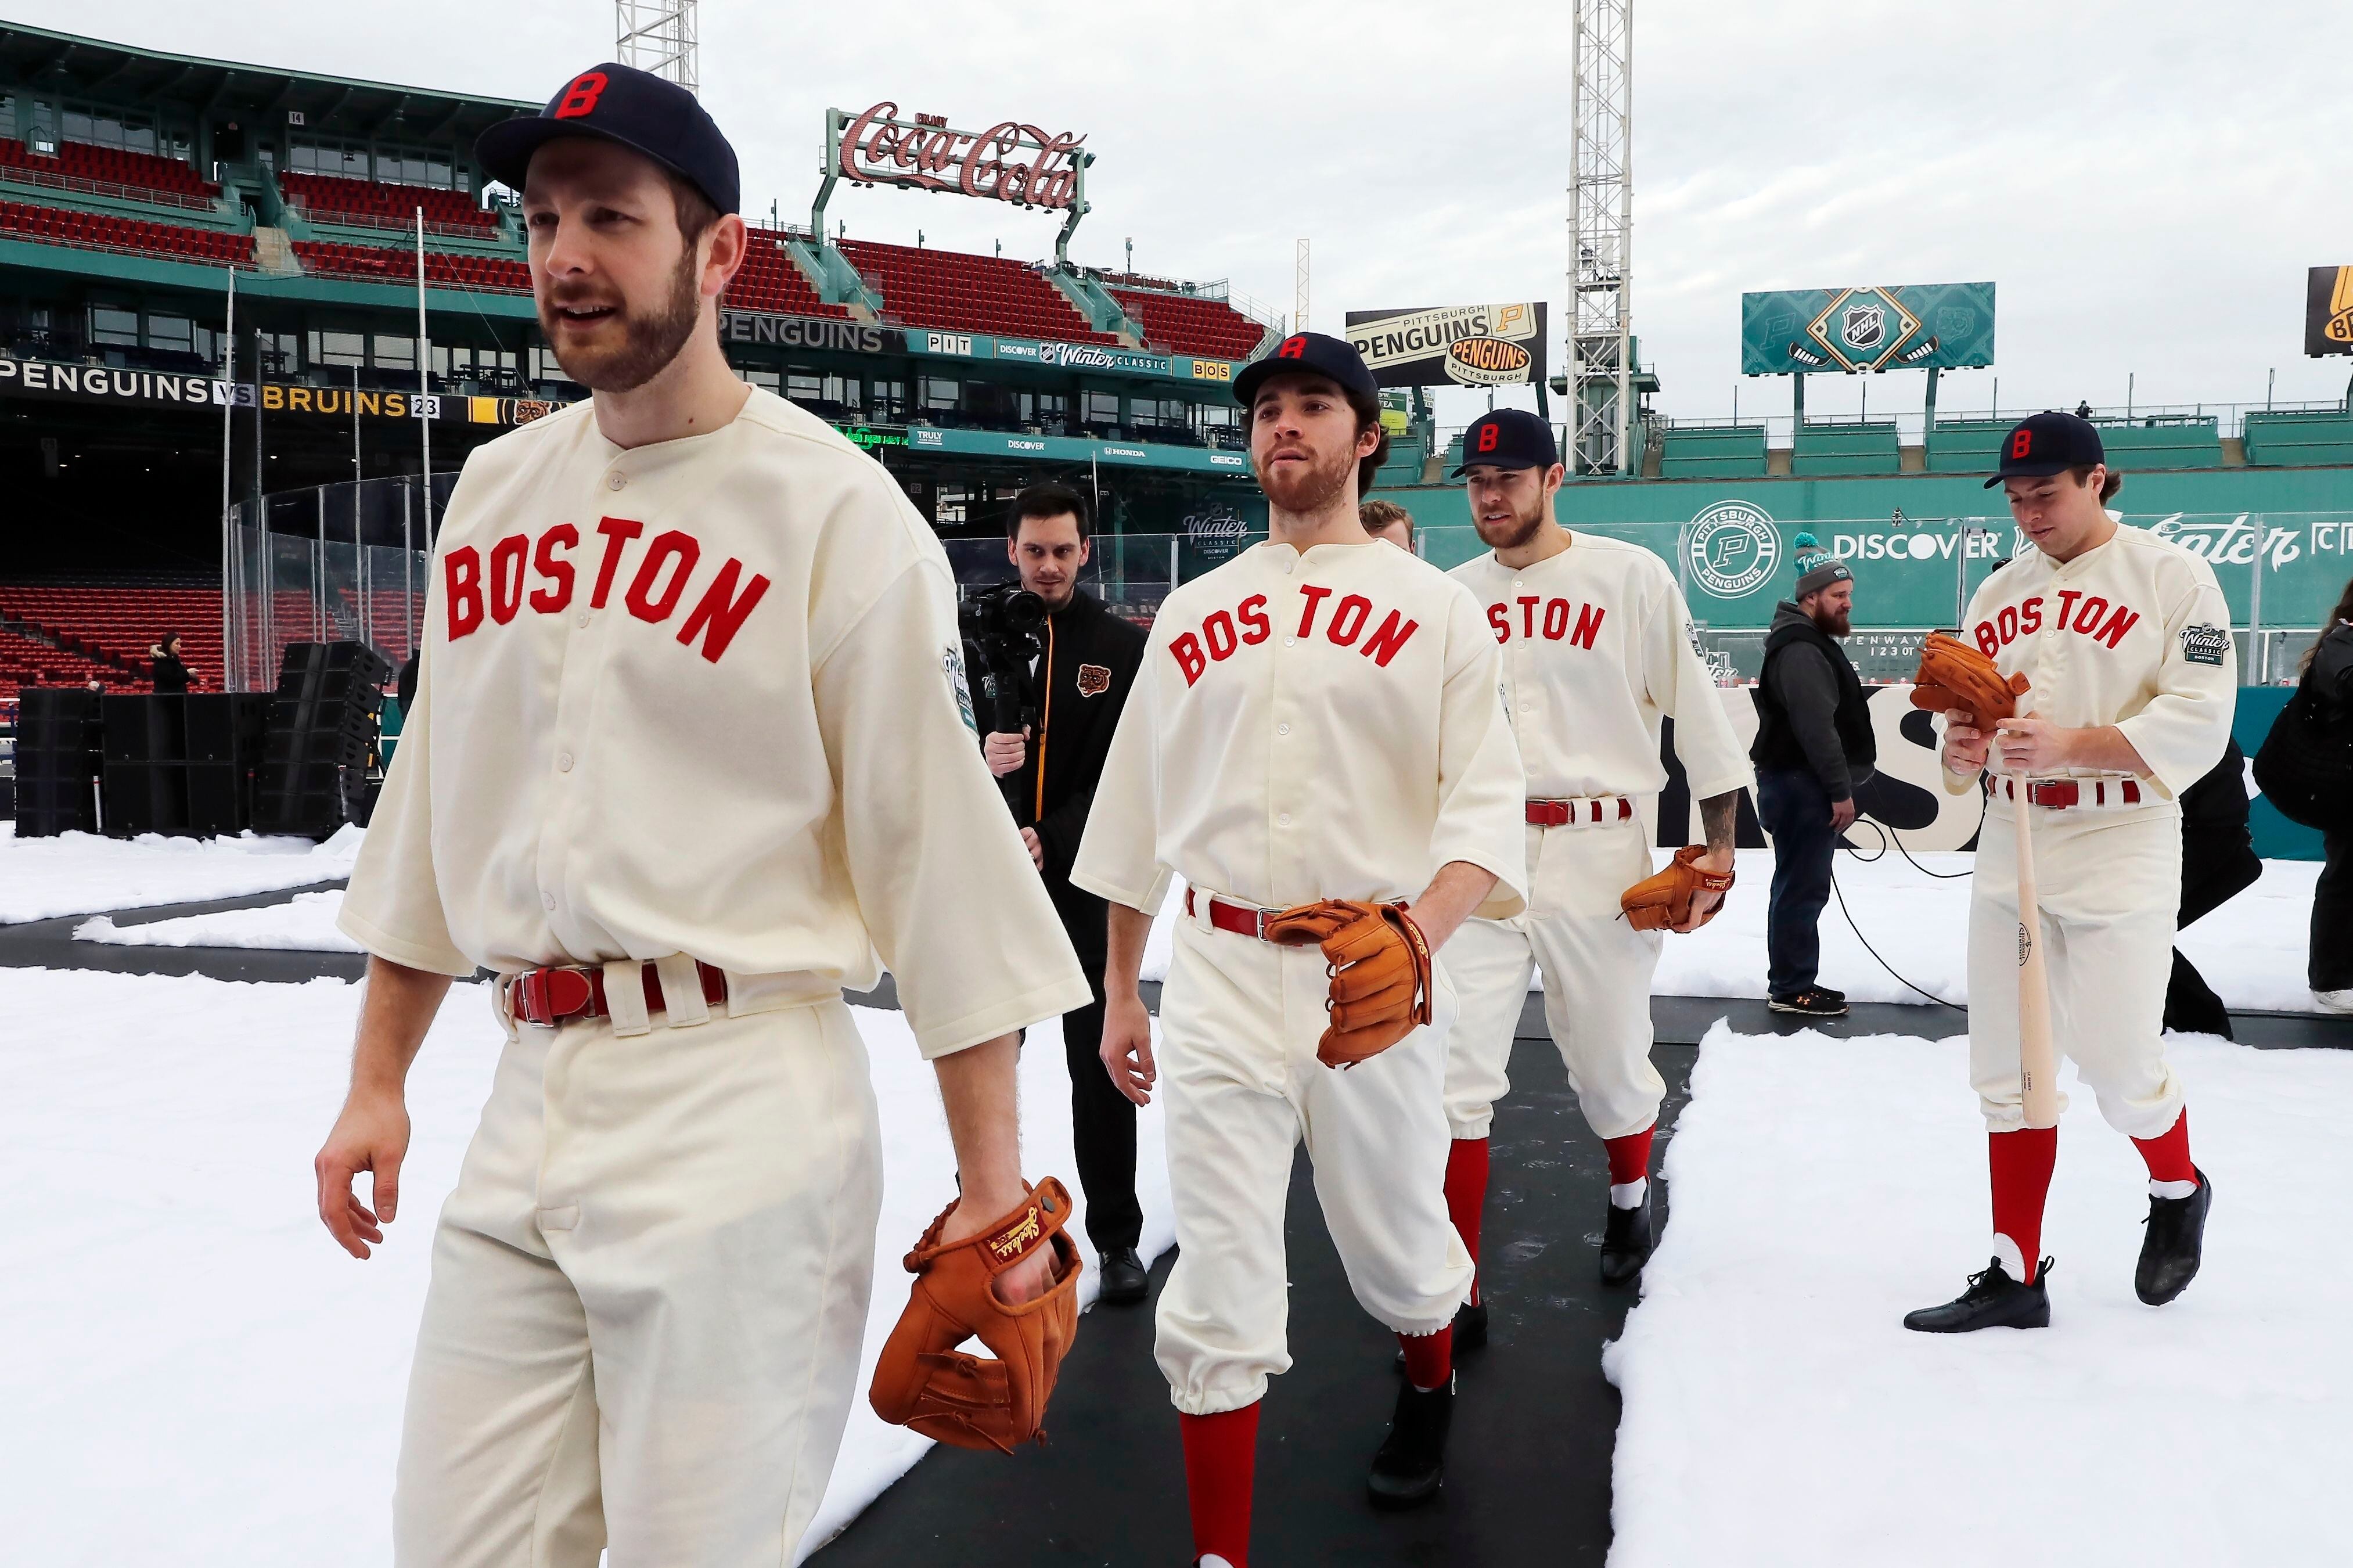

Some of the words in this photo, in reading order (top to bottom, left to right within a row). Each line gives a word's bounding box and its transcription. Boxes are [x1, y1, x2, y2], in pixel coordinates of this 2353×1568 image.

[555, 72, 609, 120] B
[292, 113, 301, 123] 14
[915, 112, 948, 128] ENJOY
[840, 102, 1088, 208] Coca-Cola
[1404, 305, 1485, 328] PITTSBURGH
[1851, 315, 1877, 342] NHL
[930, 337, 969, 351] PIT
[1000, 344, 1037, 357] DISCOVER
[1452, 339, 1526, 370] PENGUINS
[1056, 343, 1115, 369] Winter
[1117, 357, 1166, 371] CLASSIC
[1195, 364, 1228, 377] BOS
[1452, 363, 1522, 382] PITTSBURGH
[262, 385, 405, 418] BRUINS
[415, 398, 436, 415] 23
[917, 430, 943, 440] TRULY
[1008, 440, 1045, 451] DISCOVER
[1478, 423, 1499, 452] B
[2012, 429, 2032, 459] B
[1112, 448, 1146, 458] HONDA
[1210, 455, 1242, 466] GEICO
[1183, 515, 1248, 546] Winter
[1697, 510, 1769, 542] PITTSBURGH
[1712, 533, 1751, 568] P
[1833, 533, 1999, 560] DISCOVER
[444, 516, 771, 664] BOSTON
[1701, 566, 1762, 589] PENGUINS
[1487, 595, 1606, 651] STON
[1974, 589, 2140, 661] BOSTON
[1168, 584, 1419, 689] BOSTON
[1844, 635, 1922, 646] FENWAY
[2179, 630, 2230, 651] Winter
[1880, 646, 1887, 656] 2
[1890, 646, 1898, 656] 3
[2190, 646, 2221, 654] CLASSIC
[996, 1206, 1039, 1257] Shoeless
